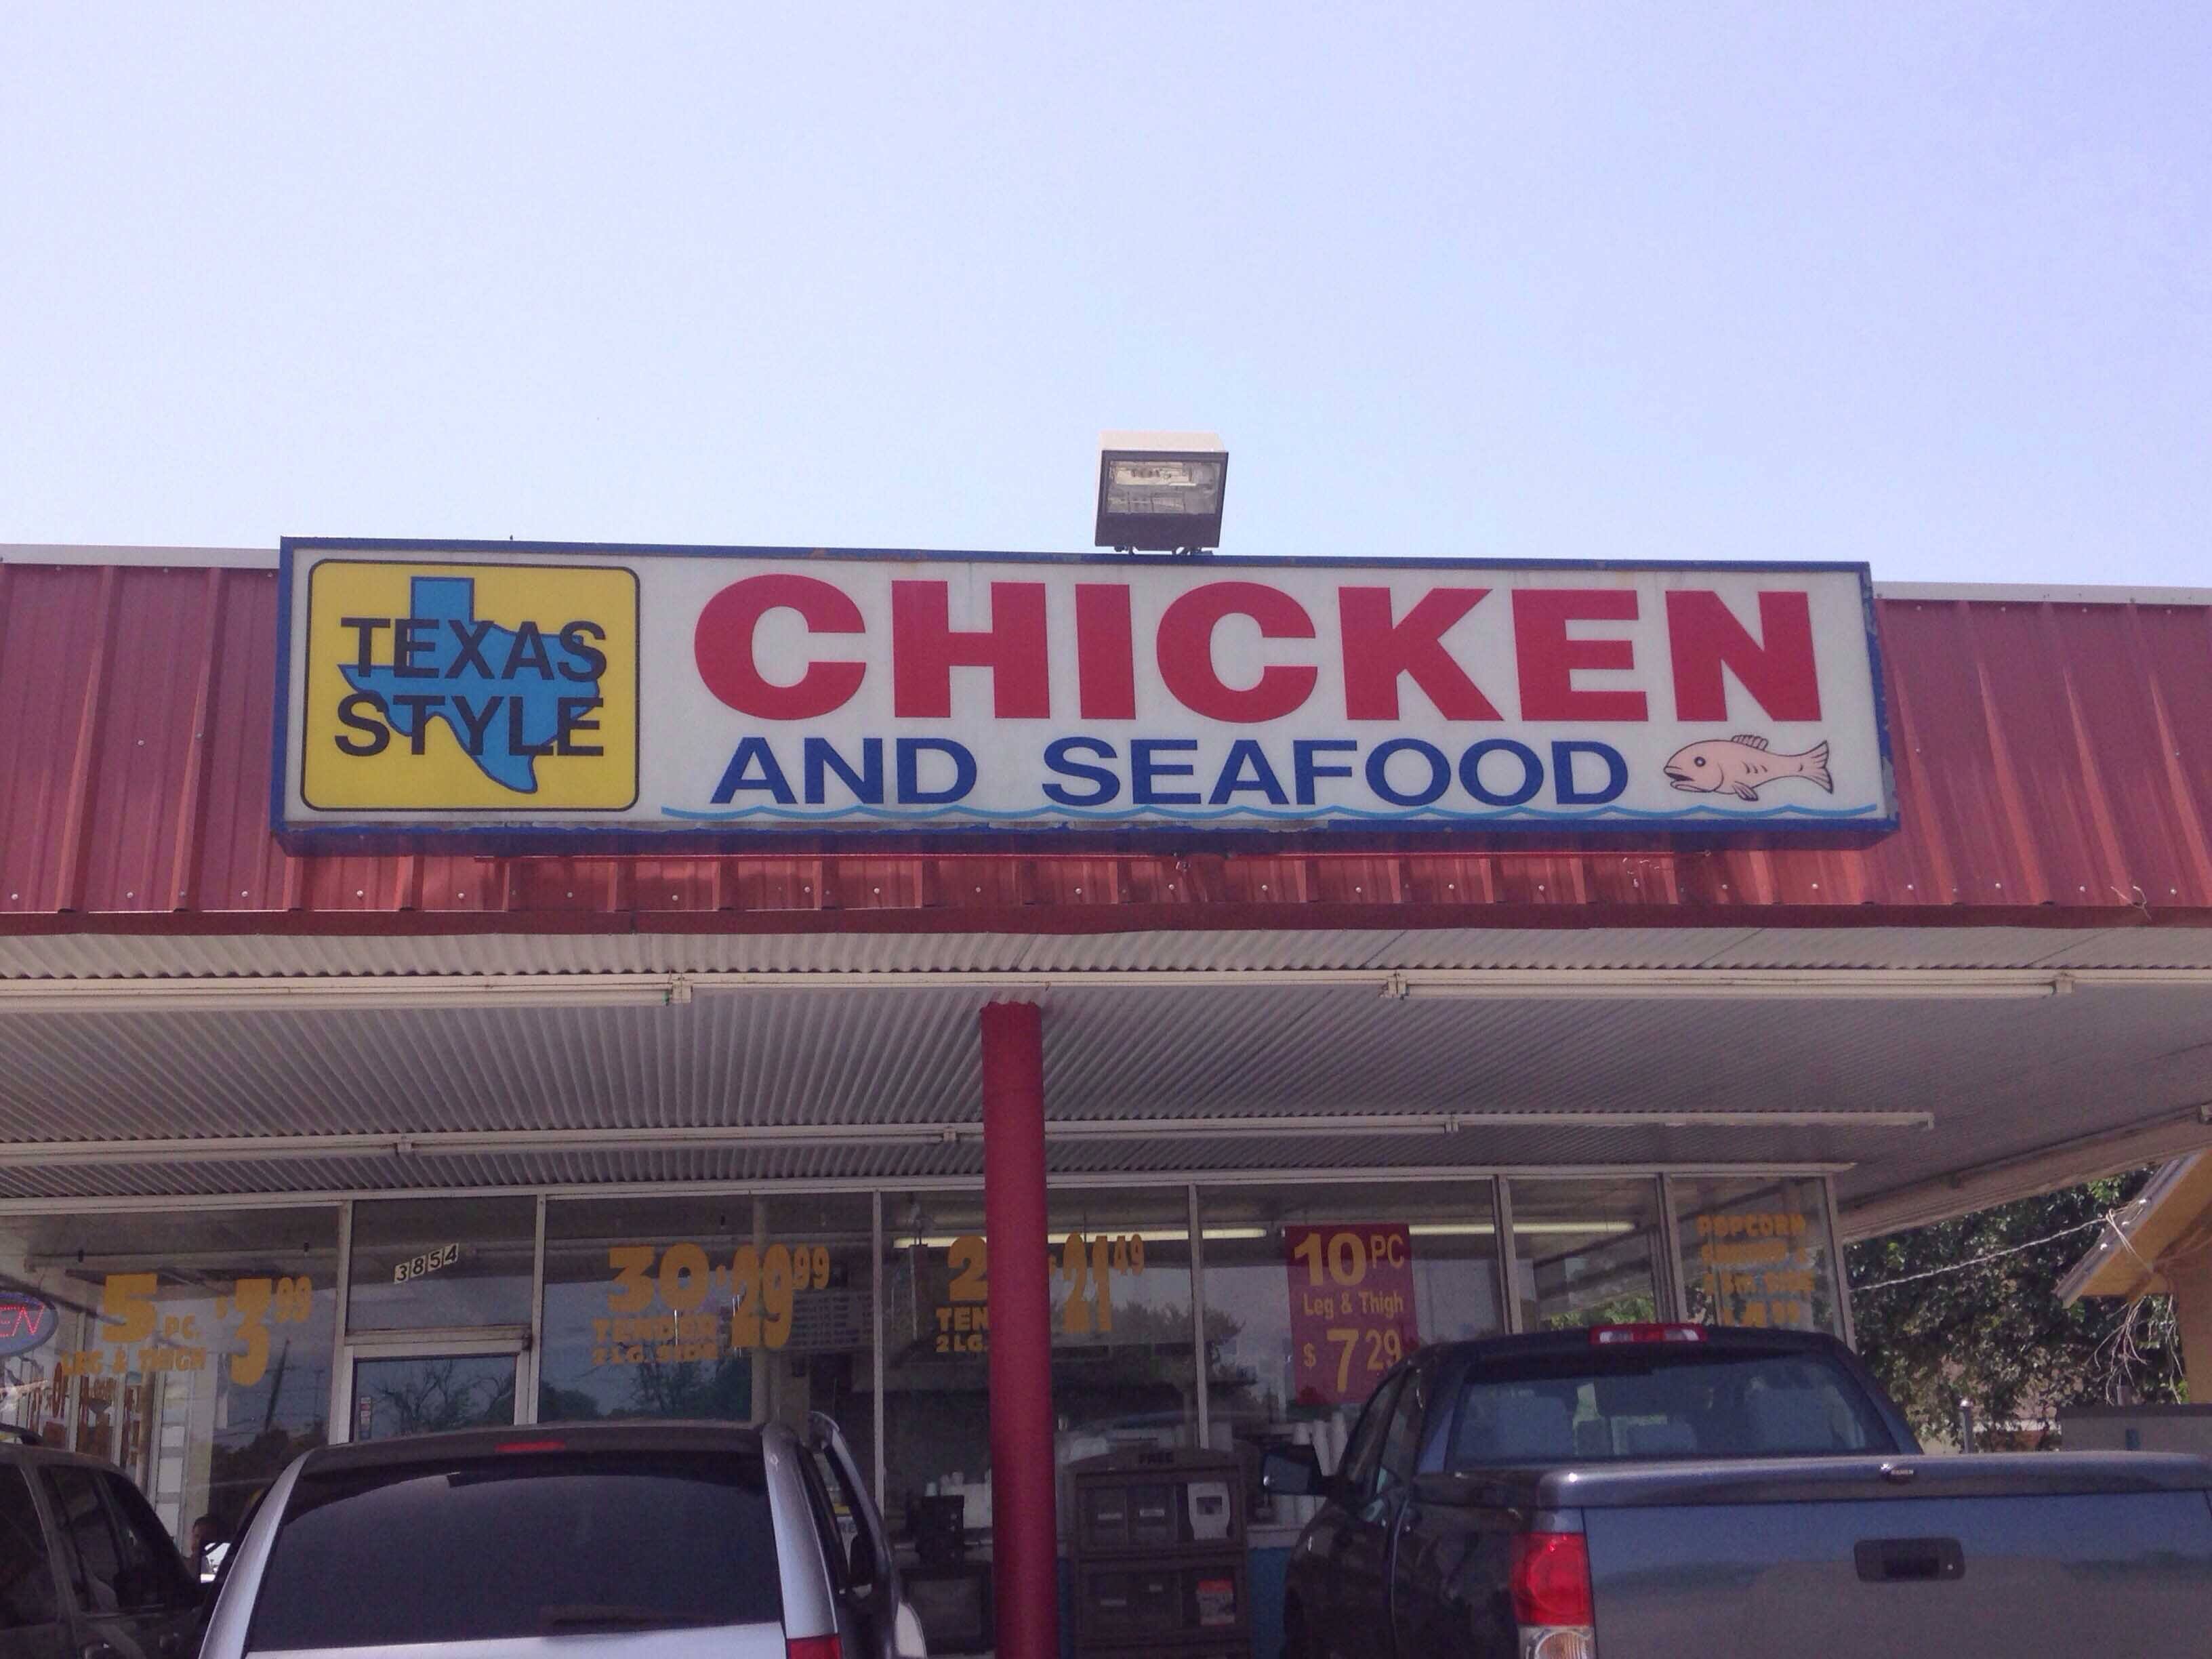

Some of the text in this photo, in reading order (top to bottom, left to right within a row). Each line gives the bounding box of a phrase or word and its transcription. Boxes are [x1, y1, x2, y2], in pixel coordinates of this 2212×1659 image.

[341, 617, 607, 682] TEXAS
[694, 573, 1822, 723] CHICKEN
[334, 692, 604, 757] STYLE
[710, 736, 1629, 806] AND SEAFOOD
[396, 1245, 457, 1282] 3854
[607, 1242, 710, 1313] 30
[1294, 1232, 1405, 1286] 10 PC
[102, 1273, 158, 1343] 5
[1303, 1290, 1404, 1319] Leg & Thigh
